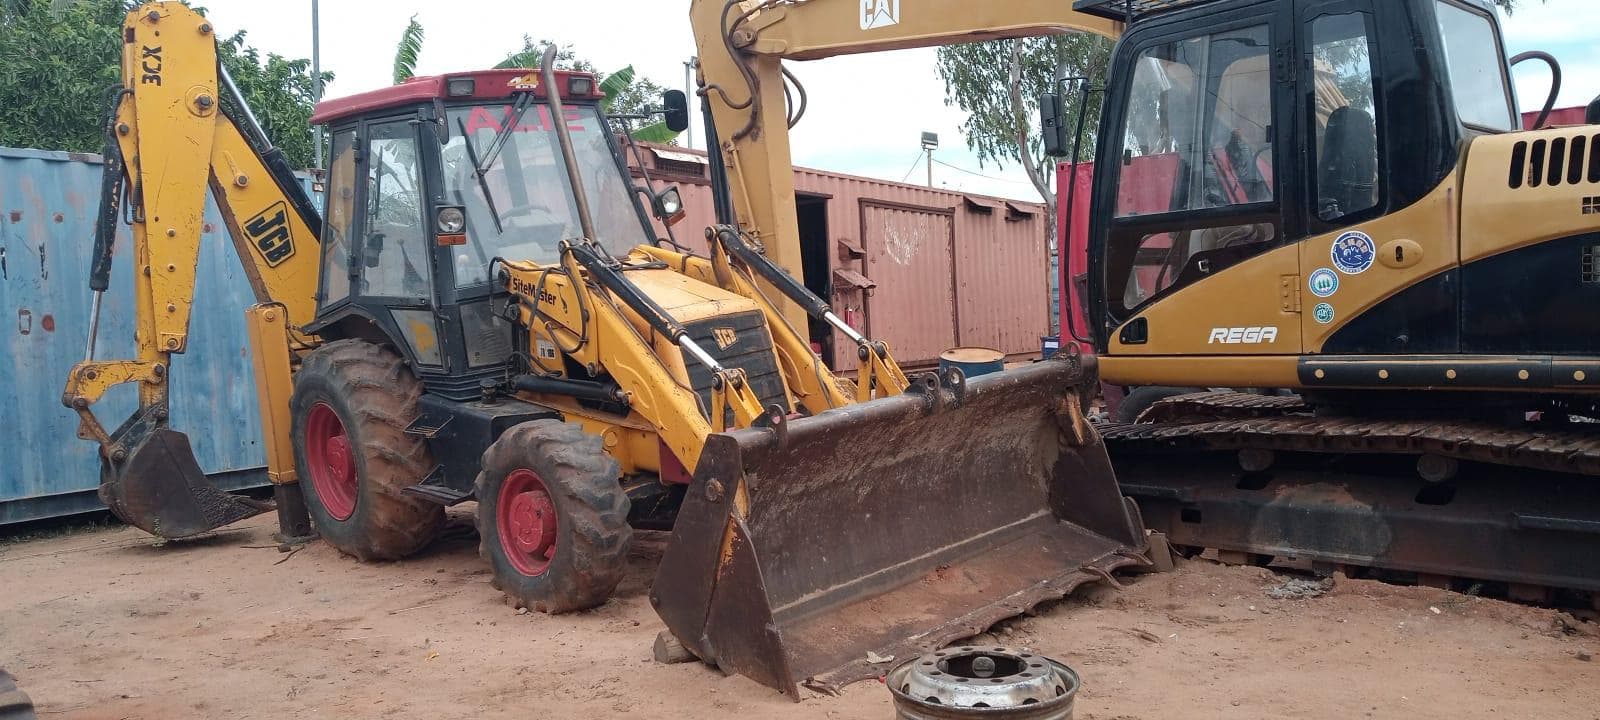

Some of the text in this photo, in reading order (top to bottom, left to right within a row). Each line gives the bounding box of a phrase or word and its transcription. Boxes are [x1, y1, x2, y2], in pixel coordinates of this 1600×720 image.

[142, 45, 161, 87] 3CX
[245, 210, 292, 264] JCB
[513, 278, 557, 305] SiteMster
[713, 328, 737, 350] JCB
[1207, 326, 1278, 344] REGA
